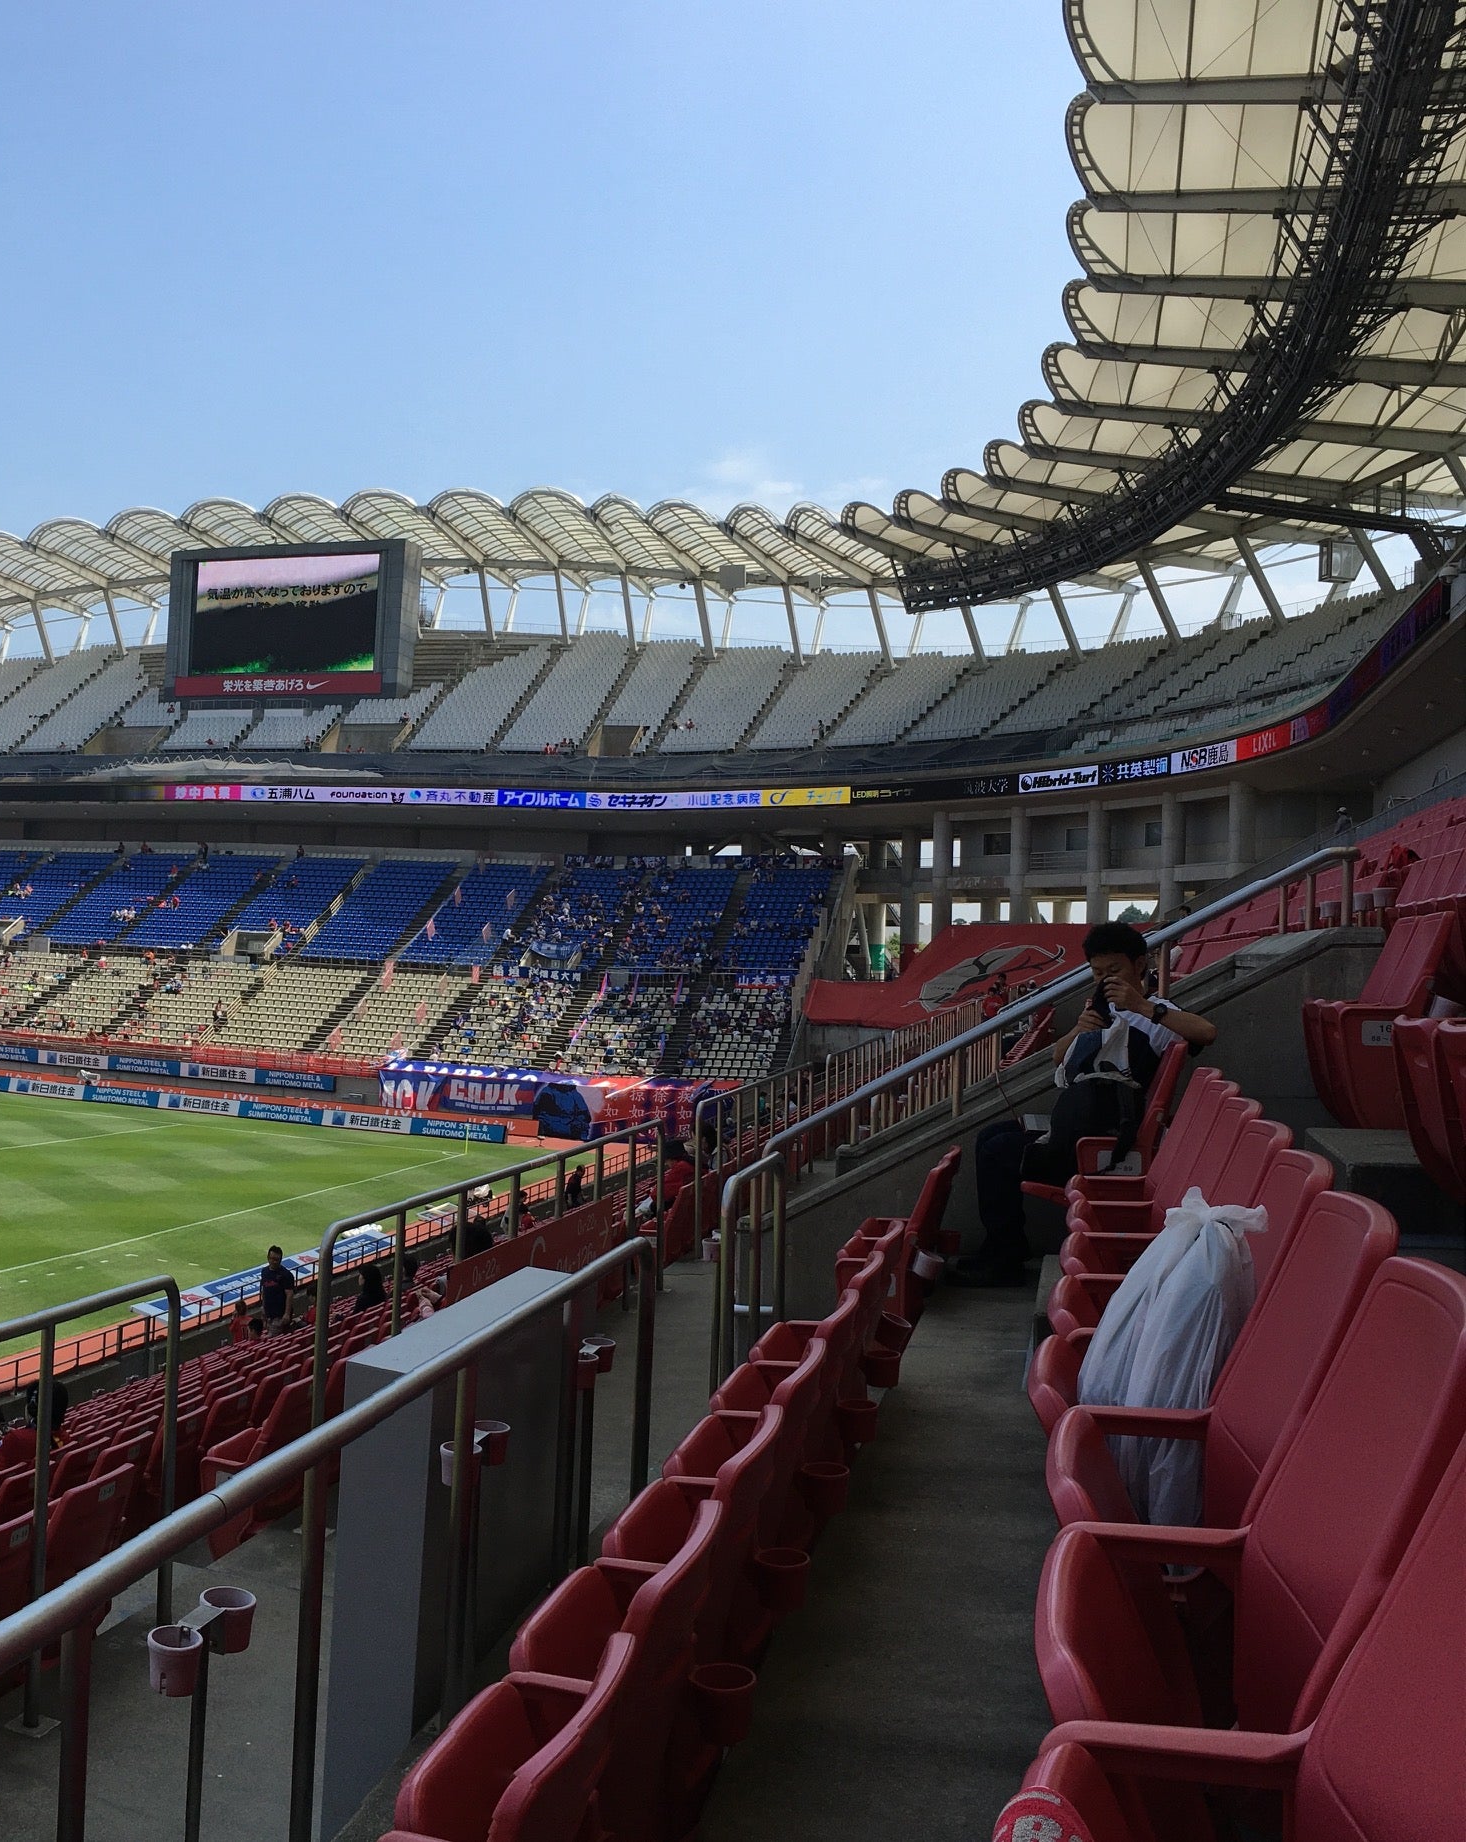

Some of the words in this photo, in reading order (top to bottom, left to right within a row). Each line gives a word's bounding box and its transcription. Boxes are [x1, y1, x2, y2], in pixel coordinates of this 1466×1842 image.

[1253, 731, 1277, 753] LIXIL
[503, 791, 580, 807] アイフルホーム
[201, 1064, 248, 1080] 新日鐵住金
[31, 1082, 76, 1097] 新日鐵住金
[182, 1096, 230, 1112] 新日鐵住金
[252, 1102, 276, 1112] NIPPON
[277, 1105, 301, 1115] STEEL
[247, 1110, 289, 1121] SUMITOMO
[290, 1113, 313, 1123] METAL
[349, 1114, 402, 1130] 新日鐵住金
